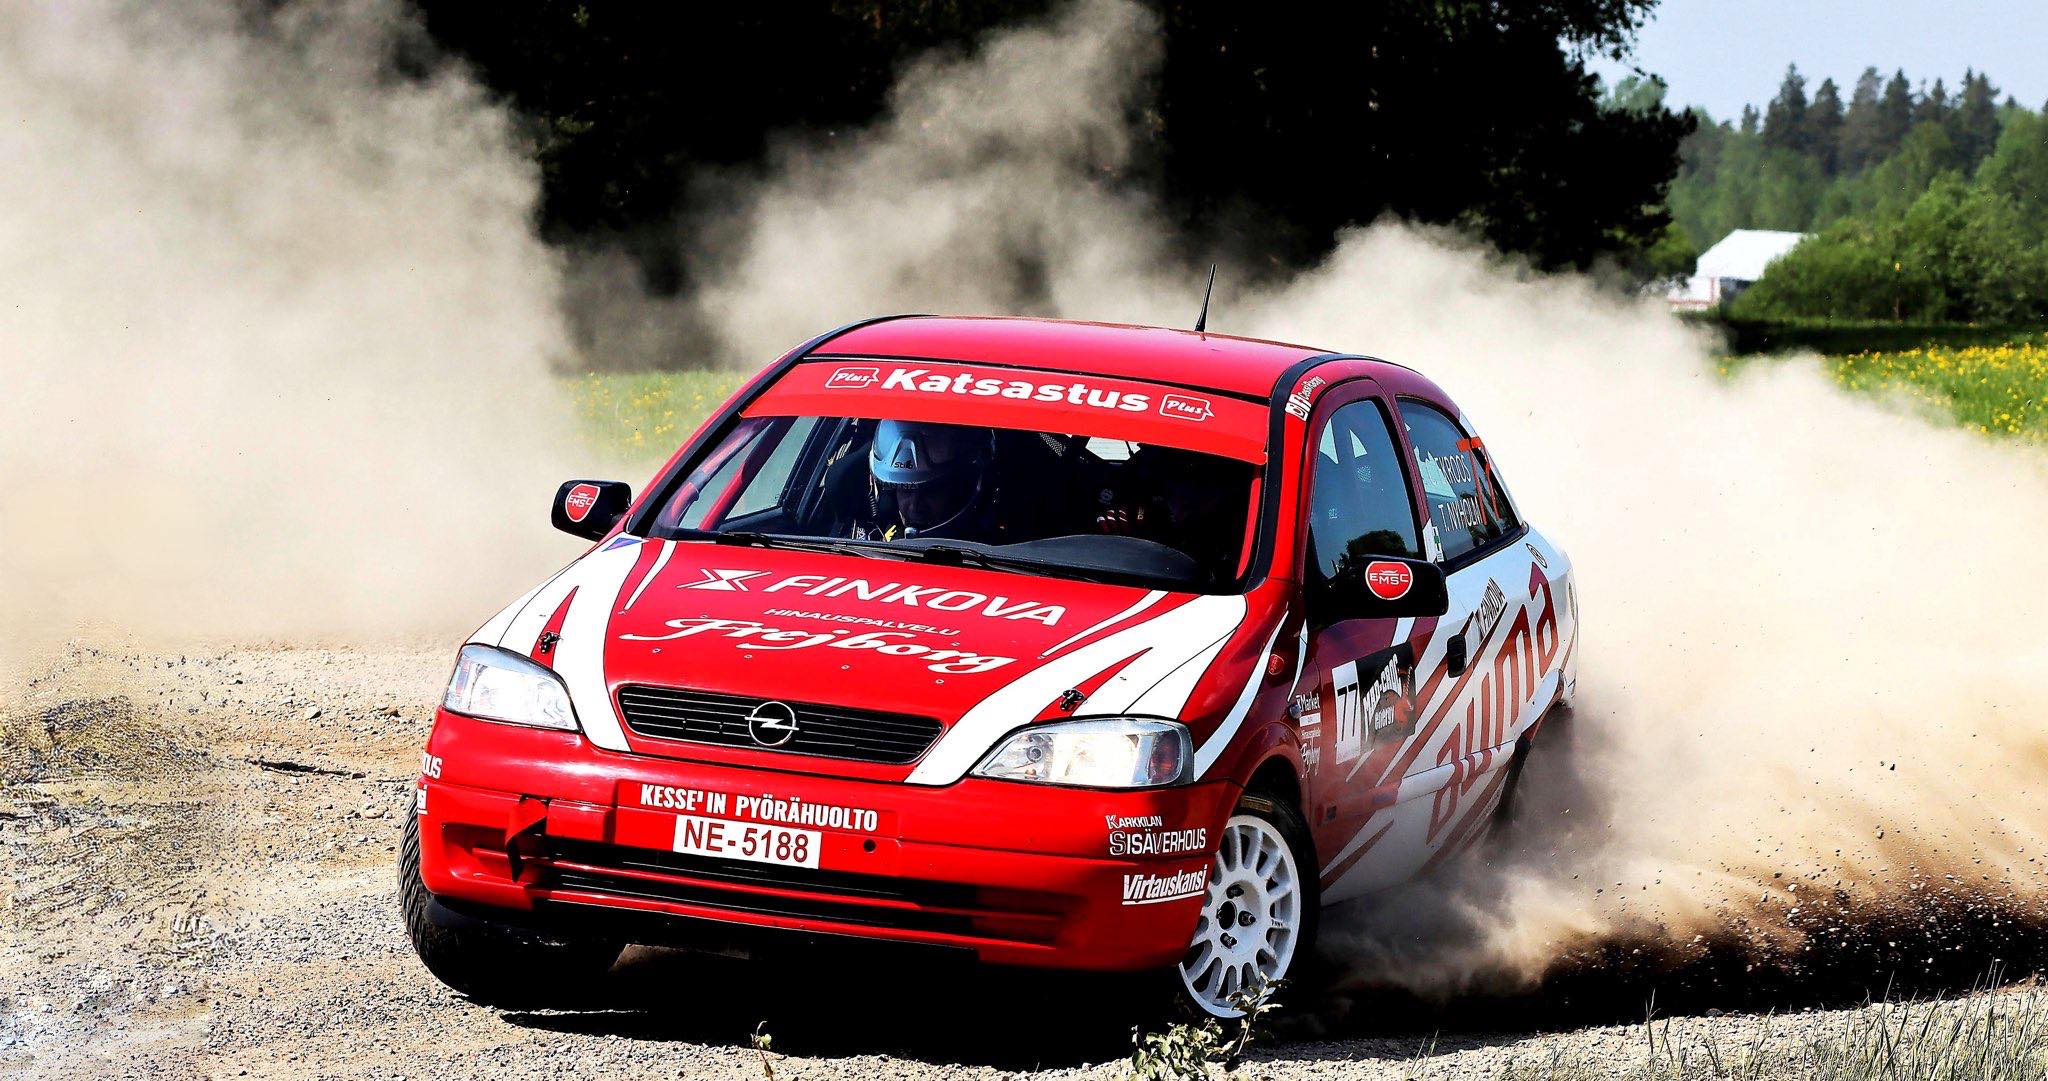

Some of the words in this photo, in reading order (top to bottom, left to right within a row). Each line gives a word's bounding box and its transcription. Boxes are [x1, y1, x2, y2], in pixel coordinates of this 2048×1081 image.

[834, 370, 870, 384] Plus
[881, 369, 1150, 411] Katsastus
[1166, 399, 1205, 416] Plus
[568, 494, 595, 508] EMSC
[1369, 572, 1409, 585] EMSC
[762, 576, 1067, 626] FINKOVA
[764, 608, 960, 637] HINAUSPALVELU
[619, 617, 1017, 674] Frejborg
[735, 794, 878, 831] PYÖRÄHUOLTO
[1105, 815, 1162, 829] KARKKILAN
[684, 819, 809, 863] NE-5188
[1109, 828, 1206, 855] SISÄVERHOUS
[1123, 864, 1208, 900] Virtauskansi
